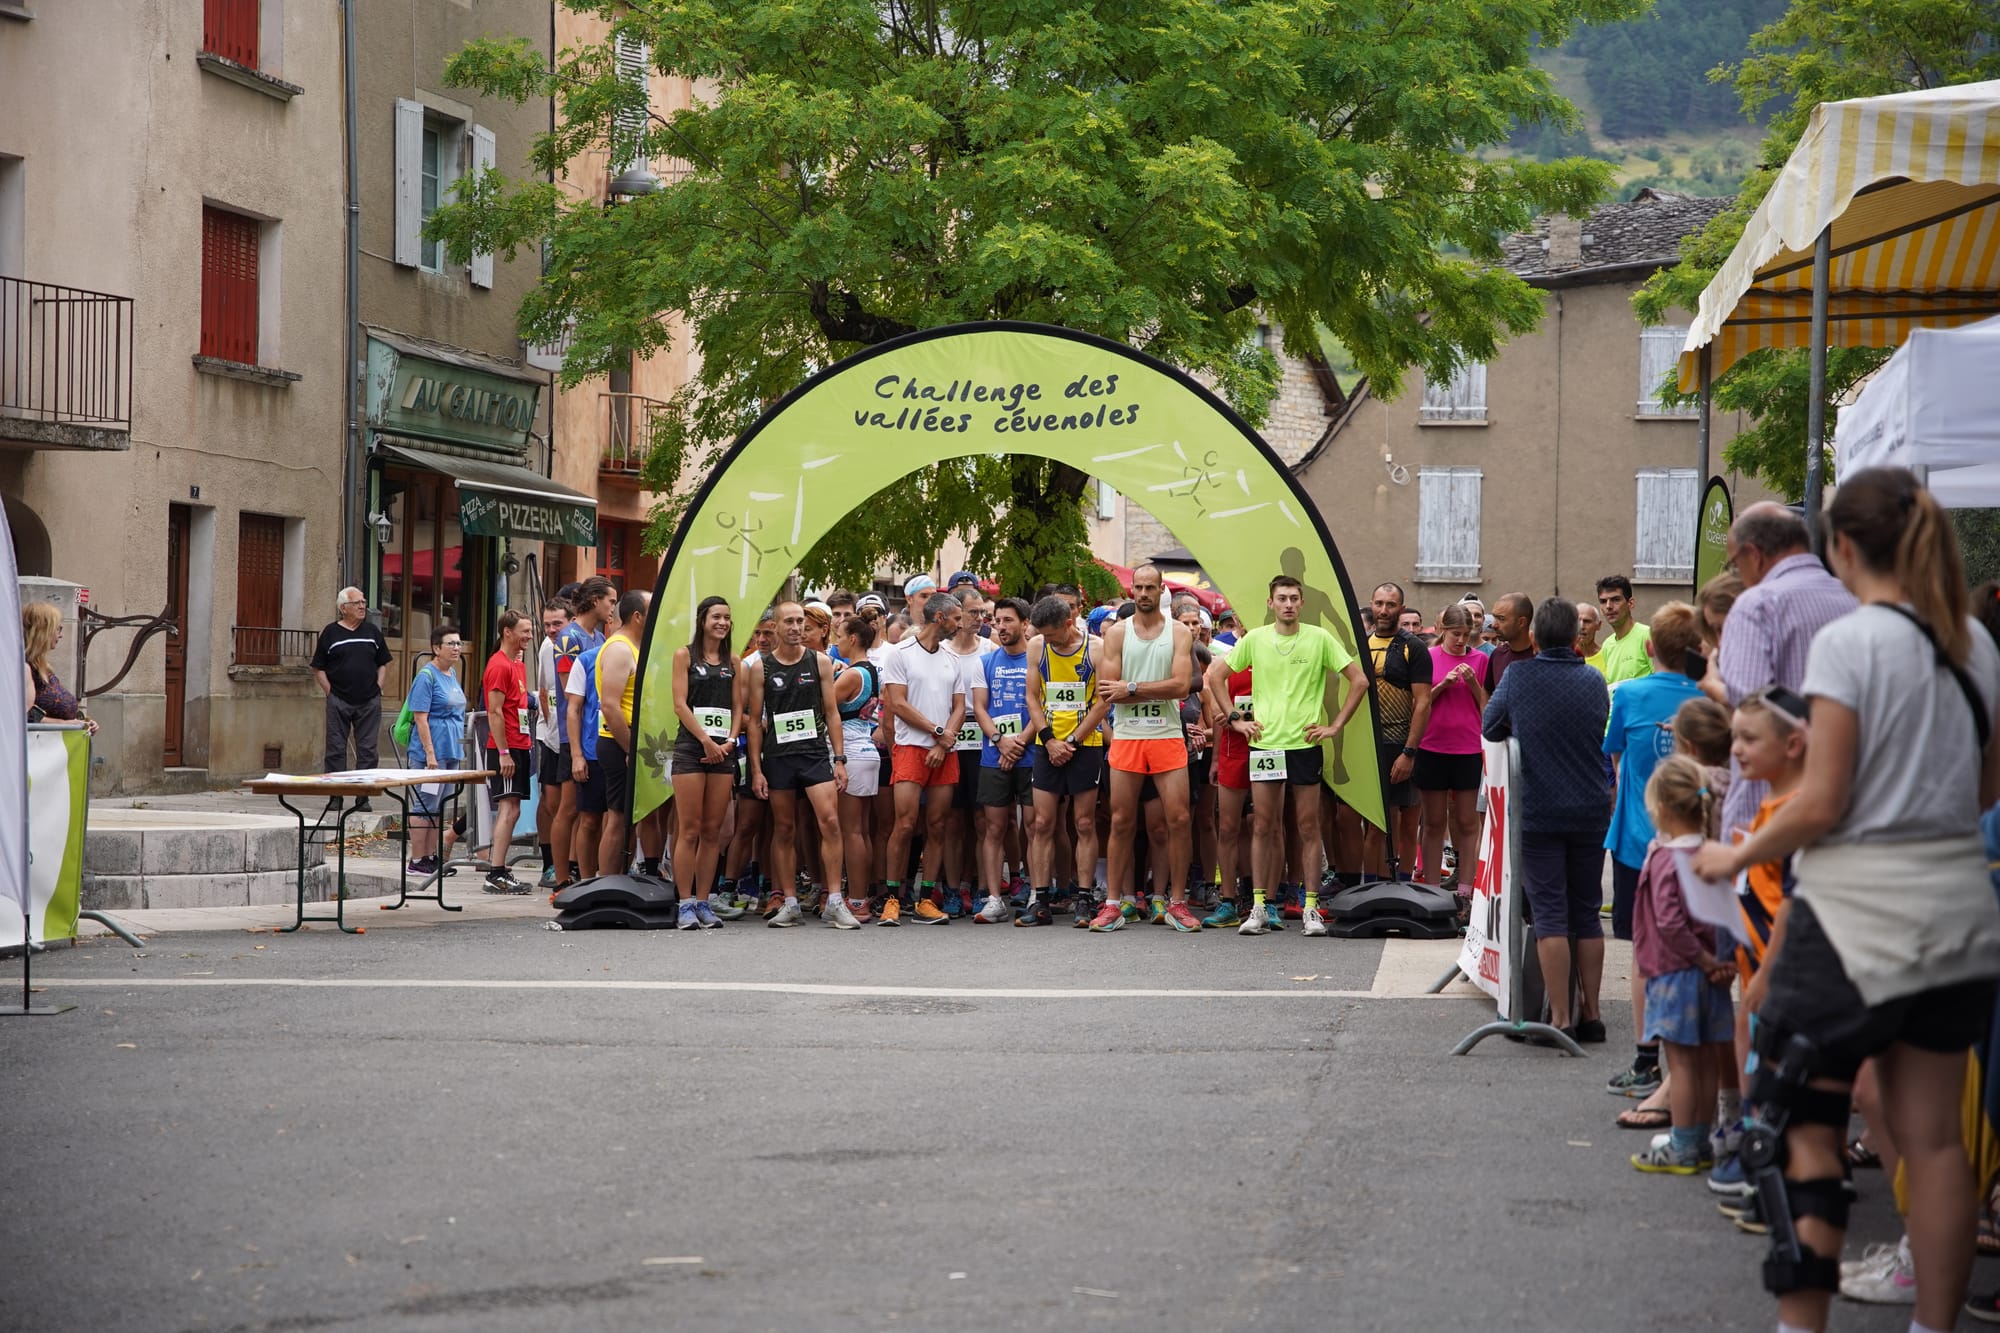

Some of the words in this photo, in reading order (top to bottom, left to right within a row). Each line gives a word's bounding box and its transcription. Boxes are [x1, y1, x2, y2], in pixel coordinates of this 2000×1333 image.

[408, 377, 443, 413] AU
[874, 374, 1042, 411] Challenge
[1064, 373, 1120, 399] des
[854, 406, 973, 433] vallées
[993, 403, 1140, 433] cévenoles
[461, 496, 482, 518] PIZZA
[479, 505, 487, 516] DE
[499, 502, 564, 536] PIZZERIA
[574, 509, 593, 533] PIZZA
[1056, 689, 1075, 701] 48
[1131, 704, 1161, 717] 115
[704, 715, 723, 727] 56
[786, 718, 805, 732] 55
[1256, 758, 1275, 770] 43
